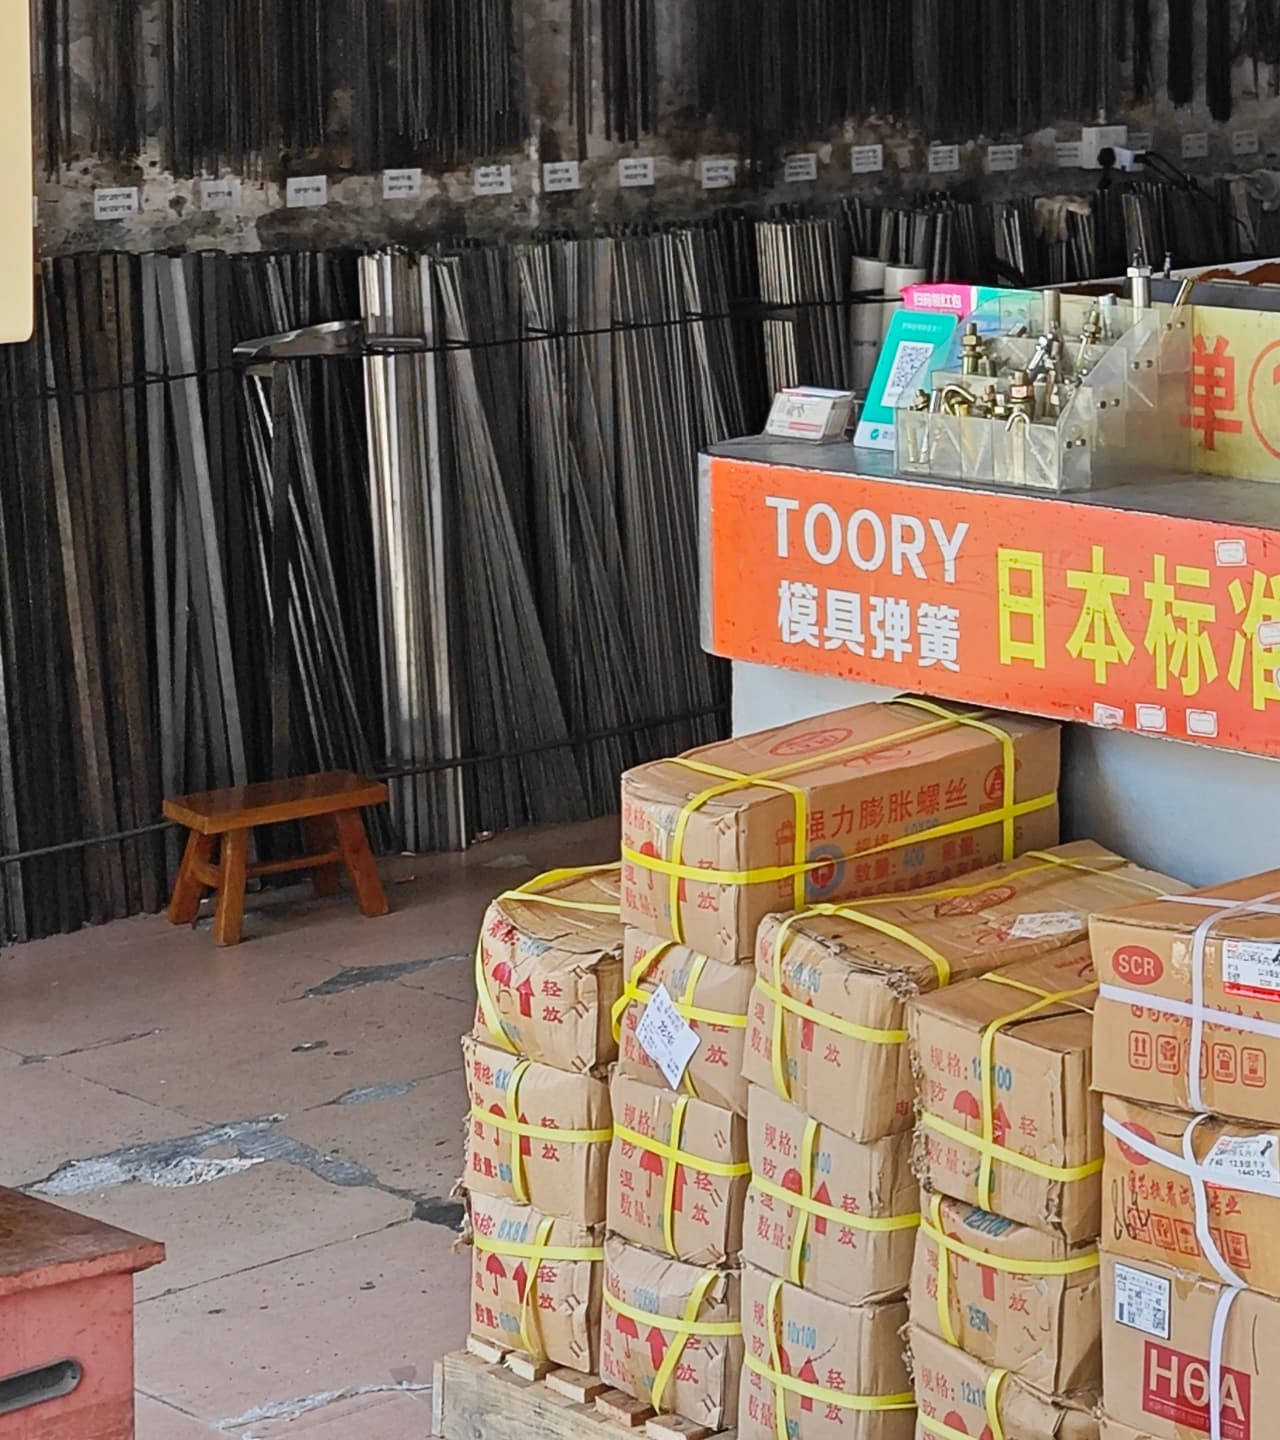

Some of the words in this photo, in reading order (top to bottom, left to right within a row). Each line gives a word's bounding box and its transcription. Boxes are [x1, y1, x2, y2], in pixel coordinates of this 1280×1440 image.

[764, 495, 970, 584] TOORY
[777, 579, 962, 673] 模具弹簧
[807, 776, 969, 843] 强力膨胀螺丝
[1117, 953, 1156, 978] SCR
[541, 979, 564, 1025] 轻放
[930, 1045, 969, 1081] 规格:
[623, 1103, 656, 1139] 规格:
[763, 1122, 798, 1159] 规格:
[619, 1192, 652, 1229] 数量:
[836, 1192, 860, 1249] 轻放
[756, 1213, 793, 1251] 数量:
[537, 1263, 559, 1311] 轻放
[823, 1367, 846, 1426] 轻放
[921, 1367, 955, 1403] 规格:
